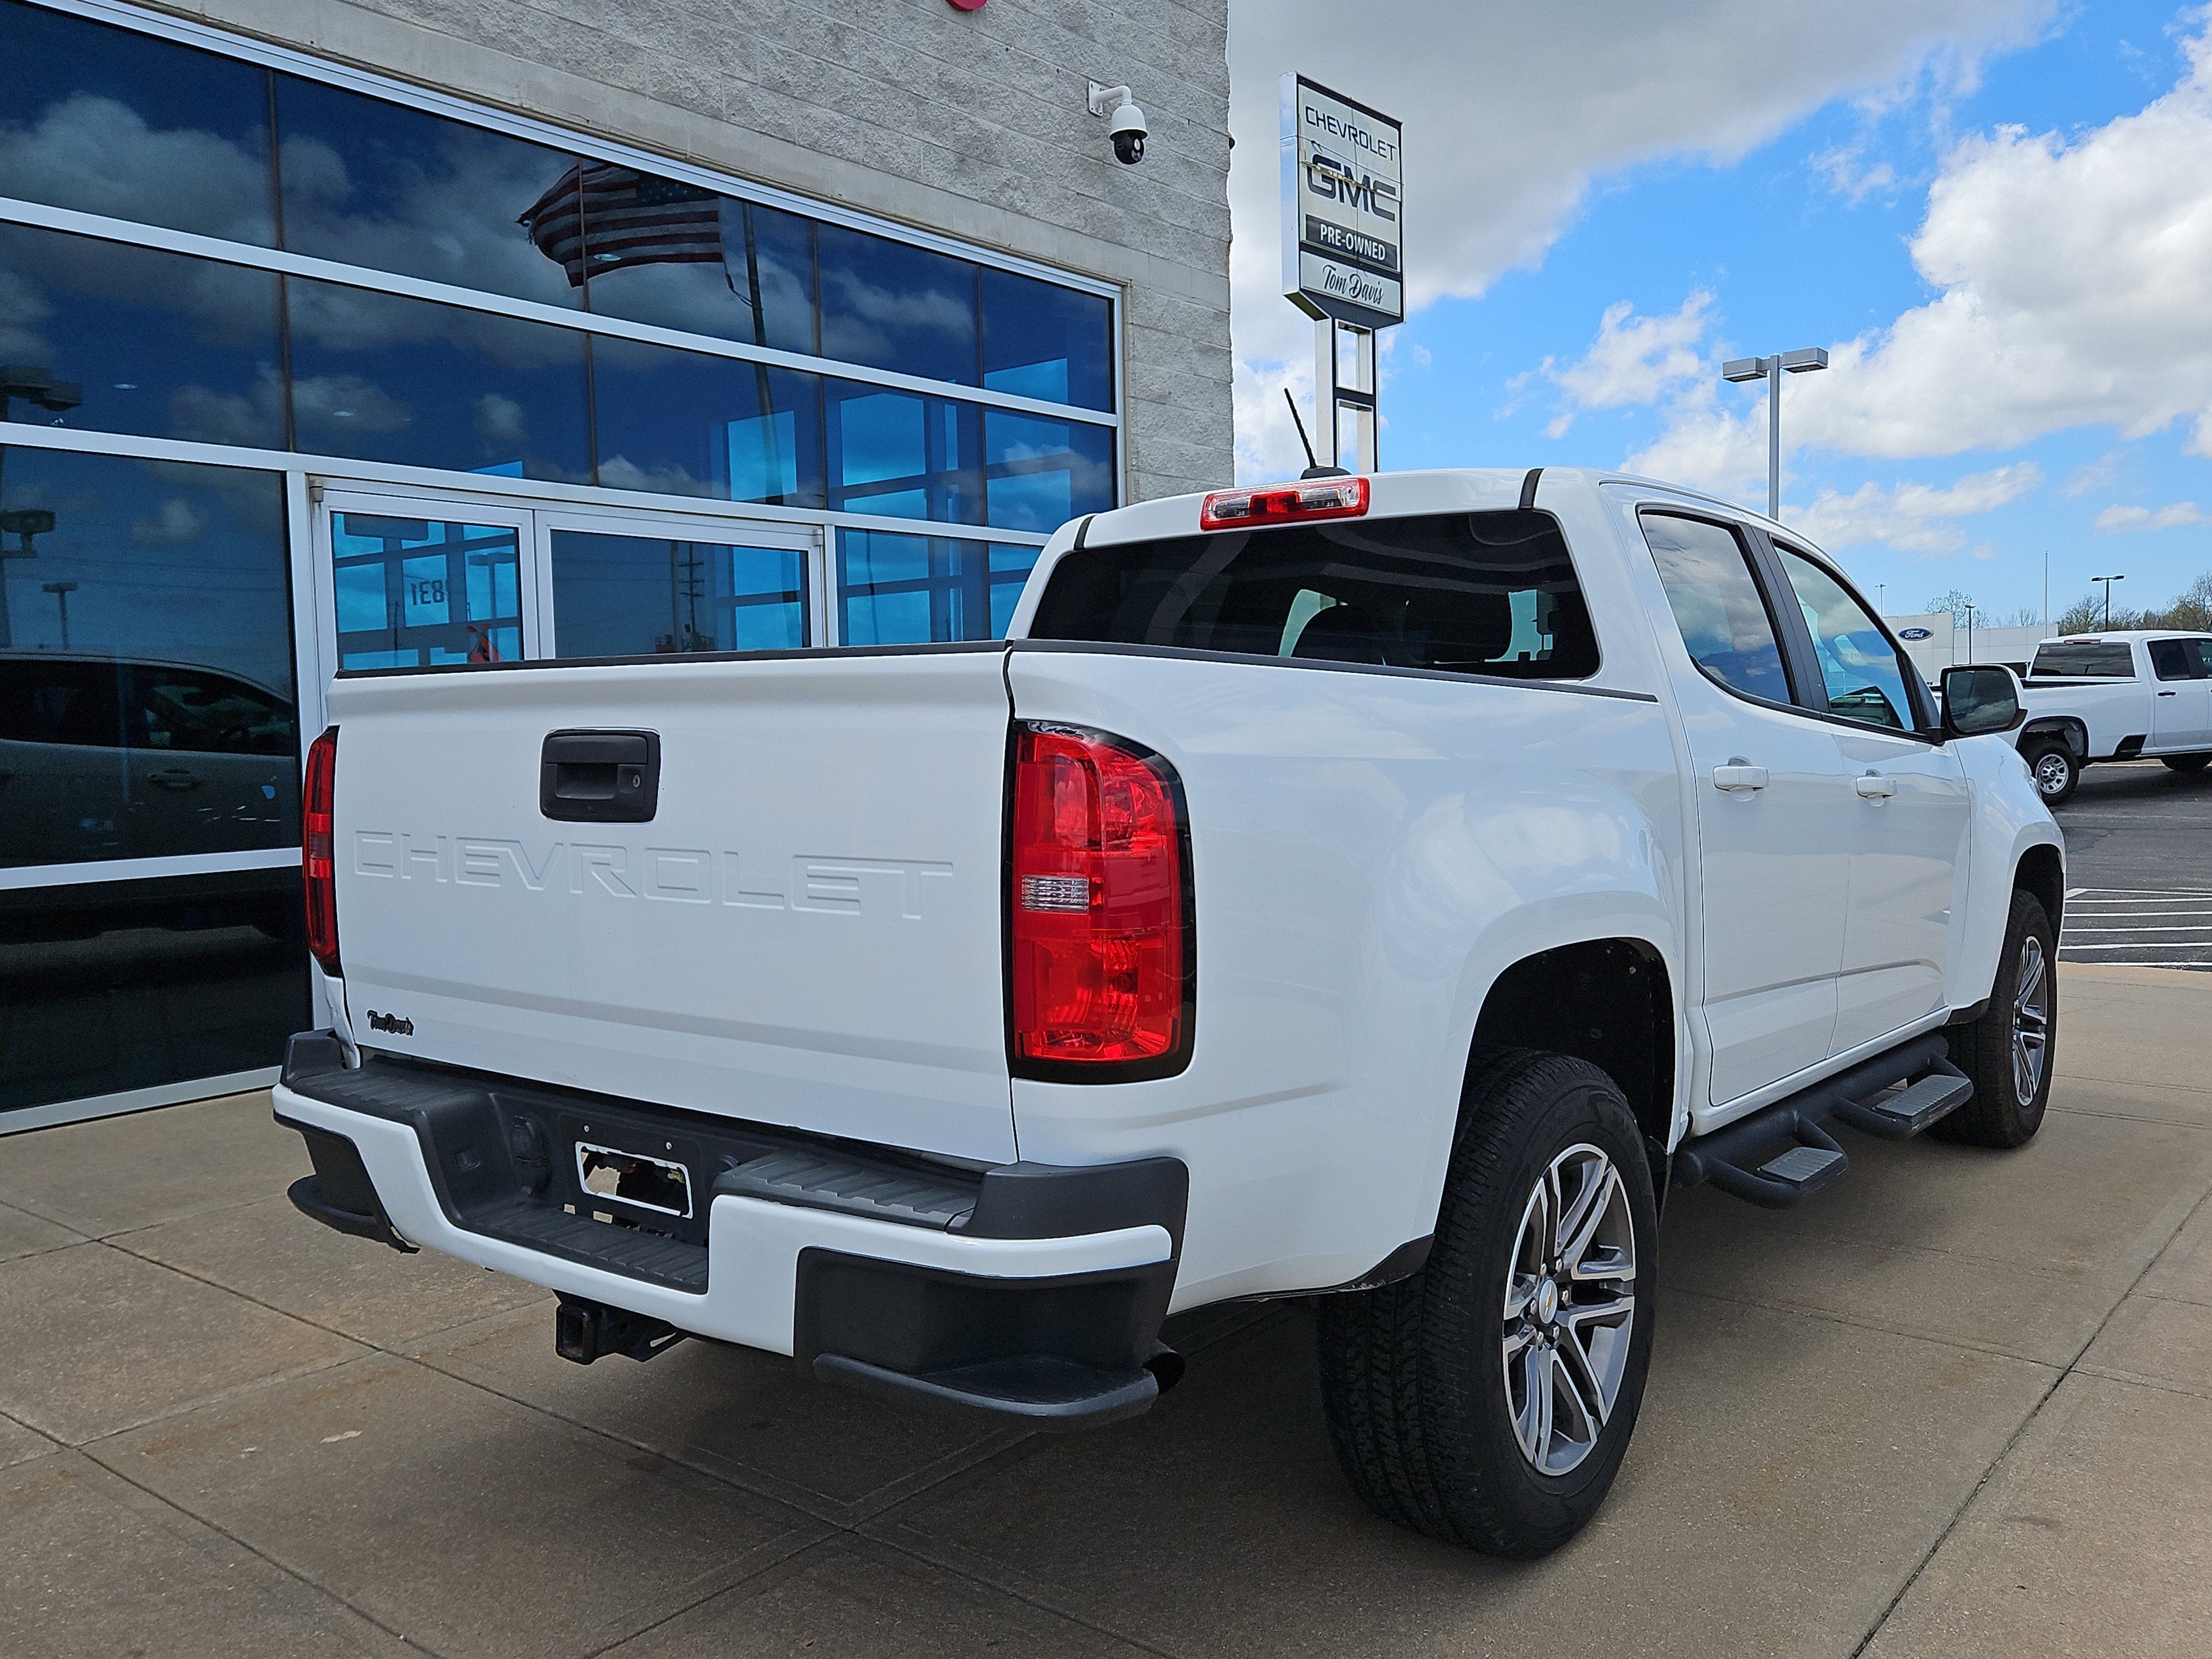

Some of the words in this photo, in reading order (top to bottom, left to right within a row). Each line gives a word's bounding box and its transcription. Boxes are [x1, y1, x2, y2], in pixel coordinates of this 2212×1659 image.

[1305, 105, 1397, 161] CHEVROLET
[1306, 153, 1396, 222] GMC
[1320, 223, 1386, 261] PRE-OWNED
[1322, 264, 1348, 294] Tom
[1349, 273, 1384, 305] Davis
[1905, 630, 1925, 638] Ford
[354, 830, 954, 920] CHEVROLET
